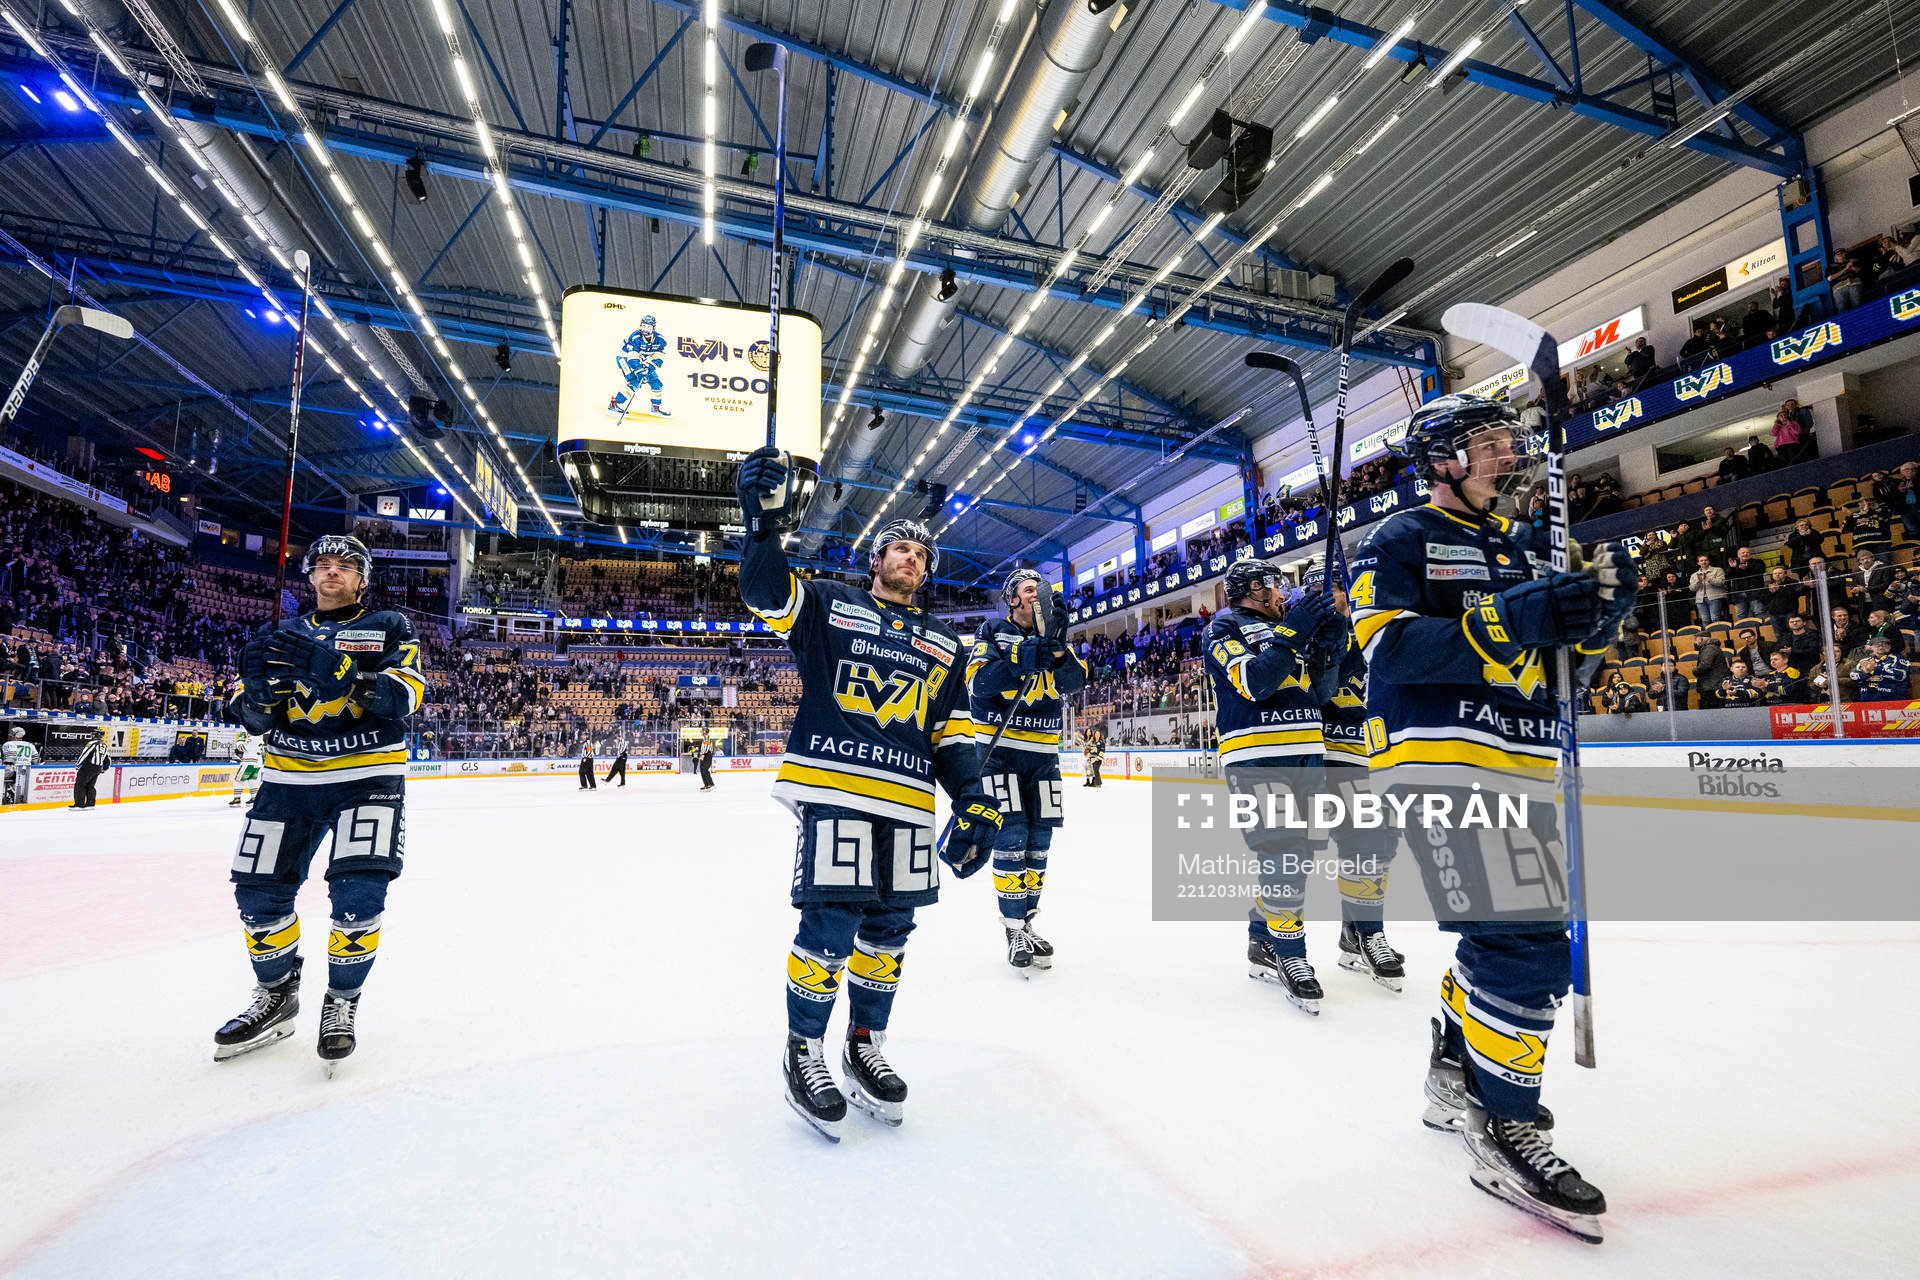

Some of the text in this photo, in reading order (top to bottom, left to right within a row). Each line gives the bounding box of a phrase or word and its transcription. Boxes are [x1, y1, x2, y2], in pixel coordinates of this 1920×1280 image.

[1751, 253, 1776, 270] Kitron
[677, 336, 729, 363] HV71
[1771, 321, 1842, 365] HV71
[687, 372, 770, 394] 19:00
[1501, 368, 1524, 383] Bygg
[1674, 362, 1733, 402] HV71
[713, 405, 745, 413] GARDEN
[1593, 397, 1643, 432] HV71
[1363, 420, 1407, 449] Liljedahl
[624, 443, 662, 456] nybergs
[726, 452, 750, 462] nybe
[1369, 489, 1399, 513] HV71
[1336, 506, 1356, 527] V71
[1548, 452, 1568, 573] BAUER
[1295, 520, 1318, 541] HV71
[1439, 546, 1480, 558] Liljedah
[1434, 568, 1487, 576] INTERSPORT
[1350, 570, 1377, 608] 4
[462, 607, 492, 615] NORDLO
[841, 602, 880, 621] Liljedahl
[1479, 594, 1510, 643] BAU
[345, 631, 385, 641] Liljedahl
[836, 619, 878, 633] INTERSPORT
[338, 642, 381, 651] Passera
[926, 630, 956, 650] iljedahl
[866, 642, 928, 672] Husqvarna
[913, 638, 951, 664] Passera
[1212, 640, 1246, 667] 56
[926, 664, 949, 700] A
[833, 659, 929, 731] HV71
[16, 745, 31, 758] 70
[272, 729, 381, 753] FAGERHULT
[731, 758, 752, 766] SEW
[810, 734, 932, 776] FAGERHULT
[1688, 751, 1787, 774] Pizzeria
[409, 764, 442, 772] HUNTONIT
[461, 762, 479, 772] GLS
[129, 773, 190, 790] perforera
[1698, 774, 1781, 798] Biblos
[967, 803, 1004, 830] BAU
[862, 981, 897, 991] AXELE
